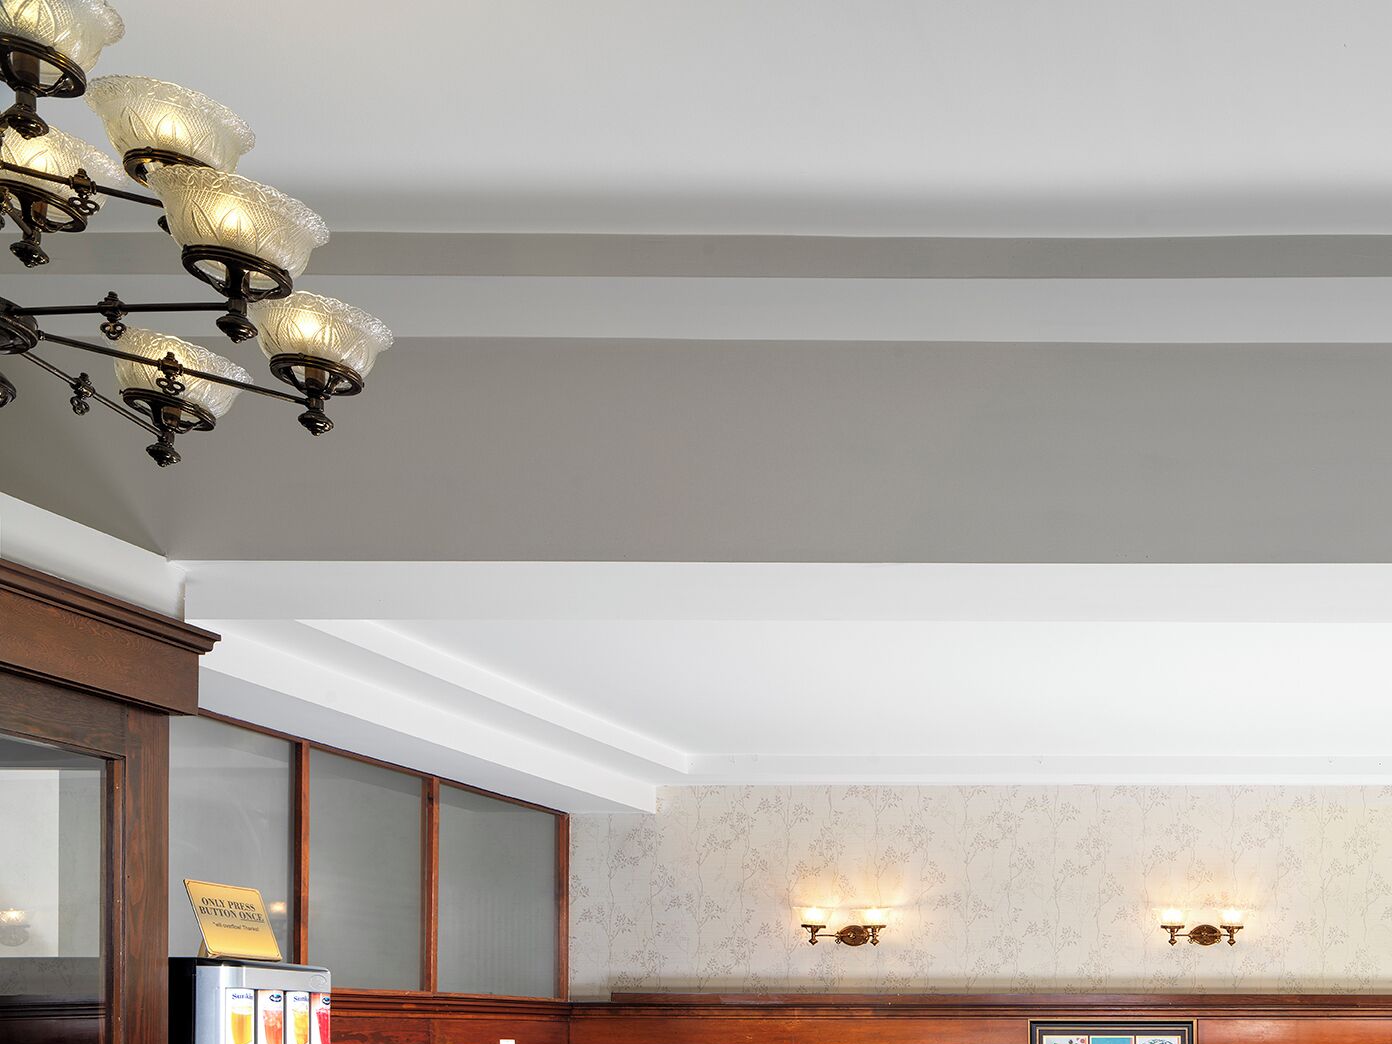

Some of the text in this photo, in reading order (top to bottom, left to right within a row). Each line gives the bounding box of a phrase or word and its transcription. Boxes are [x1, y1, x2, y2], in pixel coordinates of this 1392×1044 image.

[201, 896, 256, 911] ONLY PRESS
[199, 906, 264, 922] BUTTON ONCE
